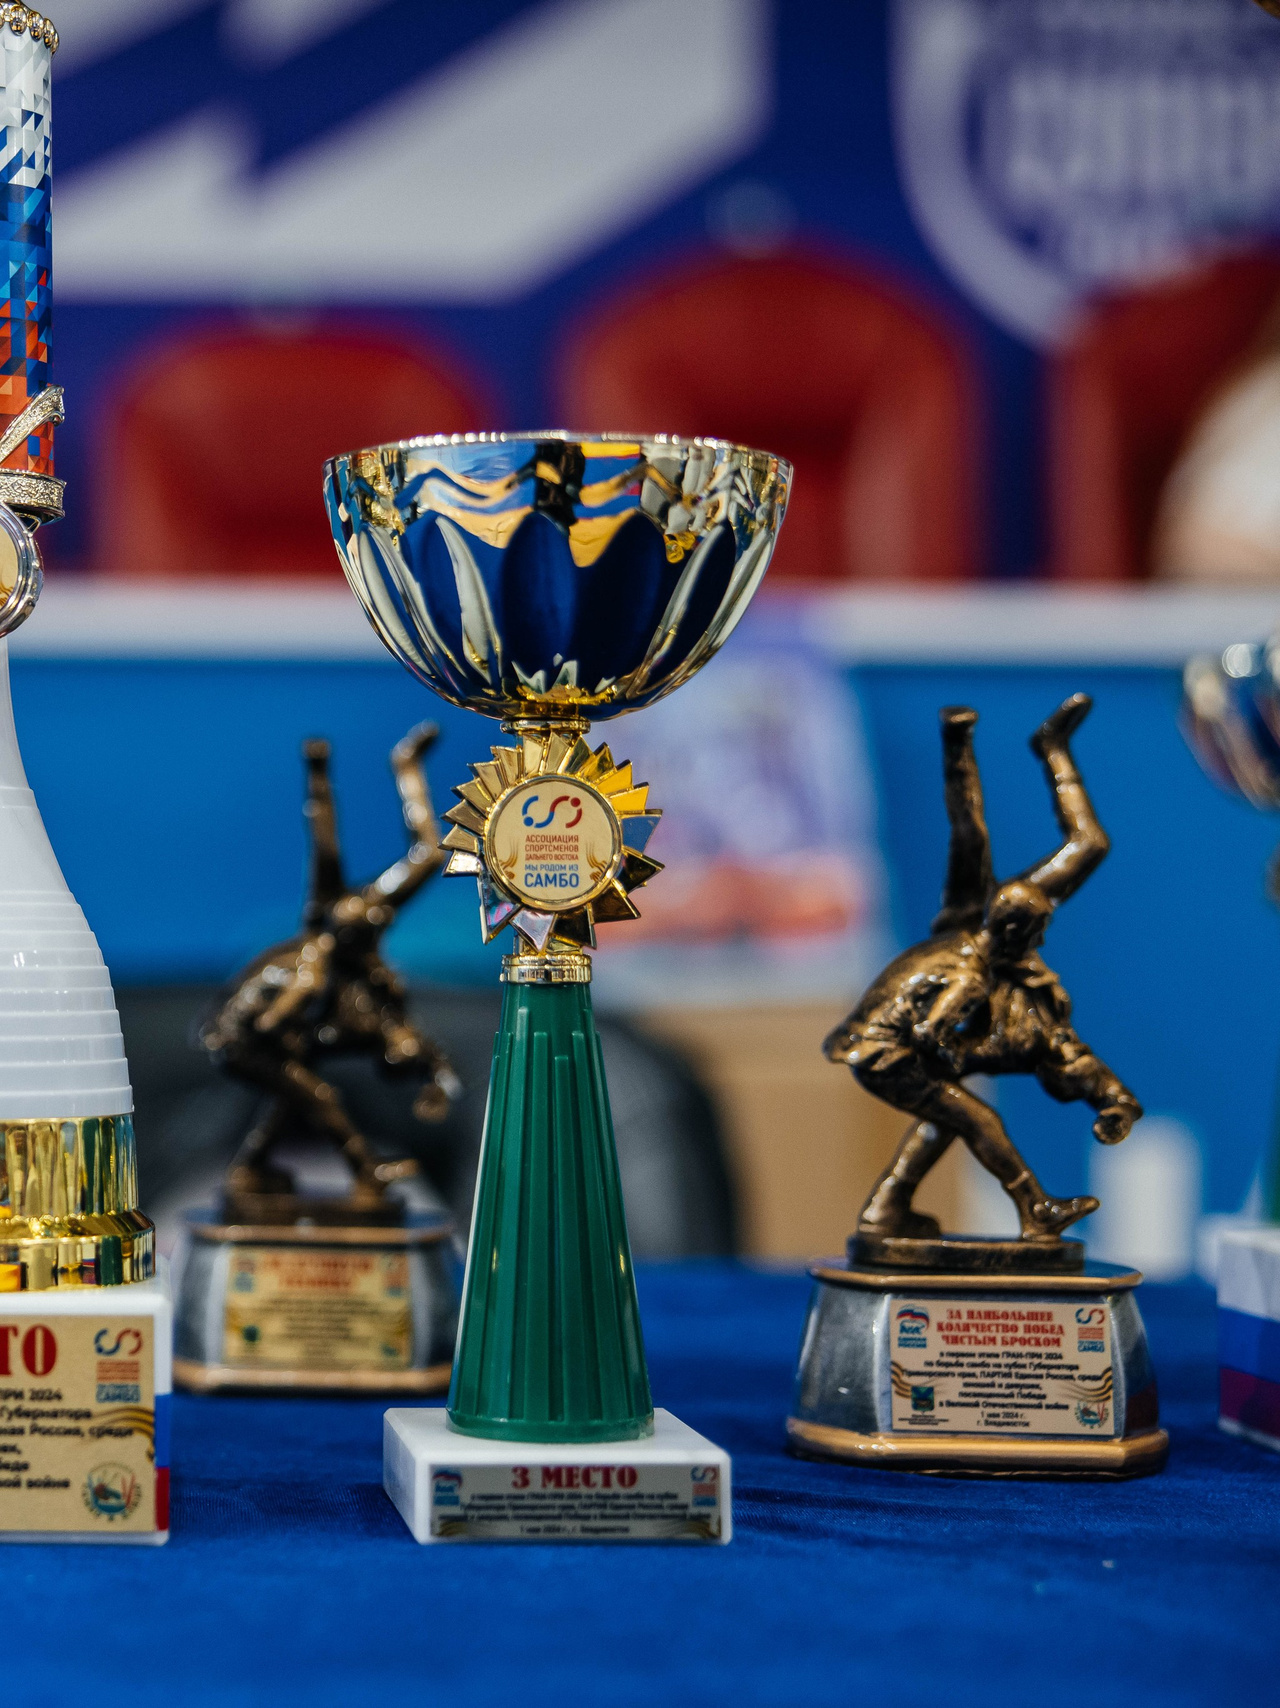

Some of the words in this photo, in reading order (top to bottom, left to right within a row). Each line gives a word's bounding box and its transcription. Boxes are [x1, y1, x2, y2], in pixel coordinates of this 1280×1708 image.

[525, 834, 579, 844] АССОЦИАЦИЯ
[524, 843, 579, 853] СПОРТСМЕНОВ
[524, 852, 553, 861] ДАЛЬНЕГО
[554, 853, 579, 861] ВОСТОКА
[524, 863, 538, 871] МЫ
[539, 863, 567, 872] РОДОМ
[568, 863, 579, 871] ИЗ
[524, 872, 580, 888] САМБО
[946, 1309, 962, 1320] ЗА
[966, 1309, 1054, 1322] НАИБОЛЬШЕЕ
[936, 1321, 1019, 1334] КОЛИЧЕСТВО
[1023, 1323, 1065, 1336] ПОБЕД
[941, 1334, 997, 1346] ЧИСТЫМ
[1000, 1336, 1062, 1347] БРОСКОМ
[511, 1465, 531, 1490] 3
[540, 1465, 639, 1490] МЕСТО
